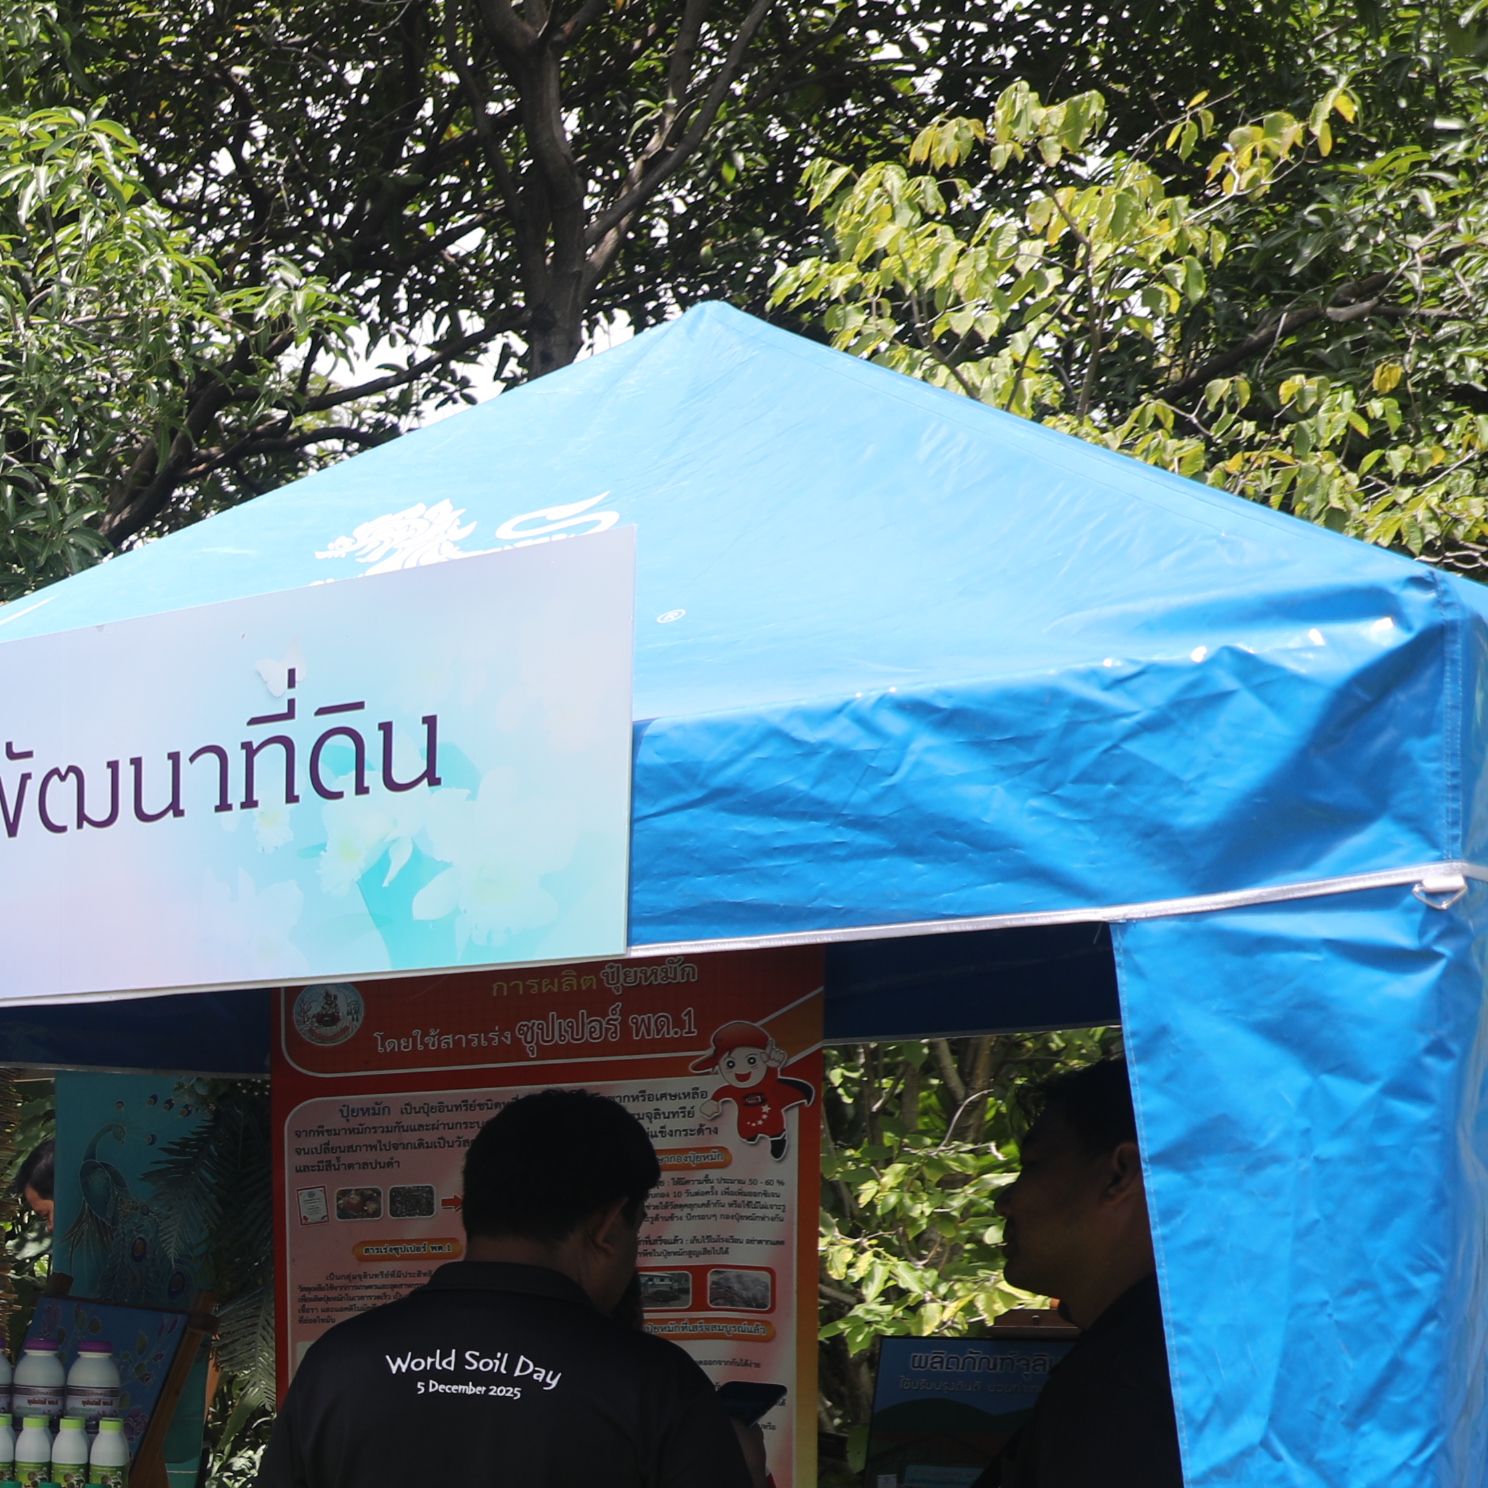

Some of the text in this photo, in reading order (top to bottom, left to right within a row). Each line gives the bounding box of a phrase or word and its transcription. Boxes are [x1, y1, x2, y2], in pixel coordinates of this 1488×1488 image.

[492, 957, 698, 997] การผลิต ปุ๋ยหมัก
[373, 1002, 698, 1058] โดยใช้สารเร่ง ซุปเปอร์ พด.1
[338, 1101, 391, 1122] ปุ๋ยหมัก
[295, 1119, 488, 1138] จากพืชมาหมักรวมกันและผ่านกระบ
[295, 1156, 401, 1174] และมีสีน้ำตาลปนดำ
[385, 1349, 562, 1390] World Soil Day
[417, 1380, 522, 1400] 5 December 2025
